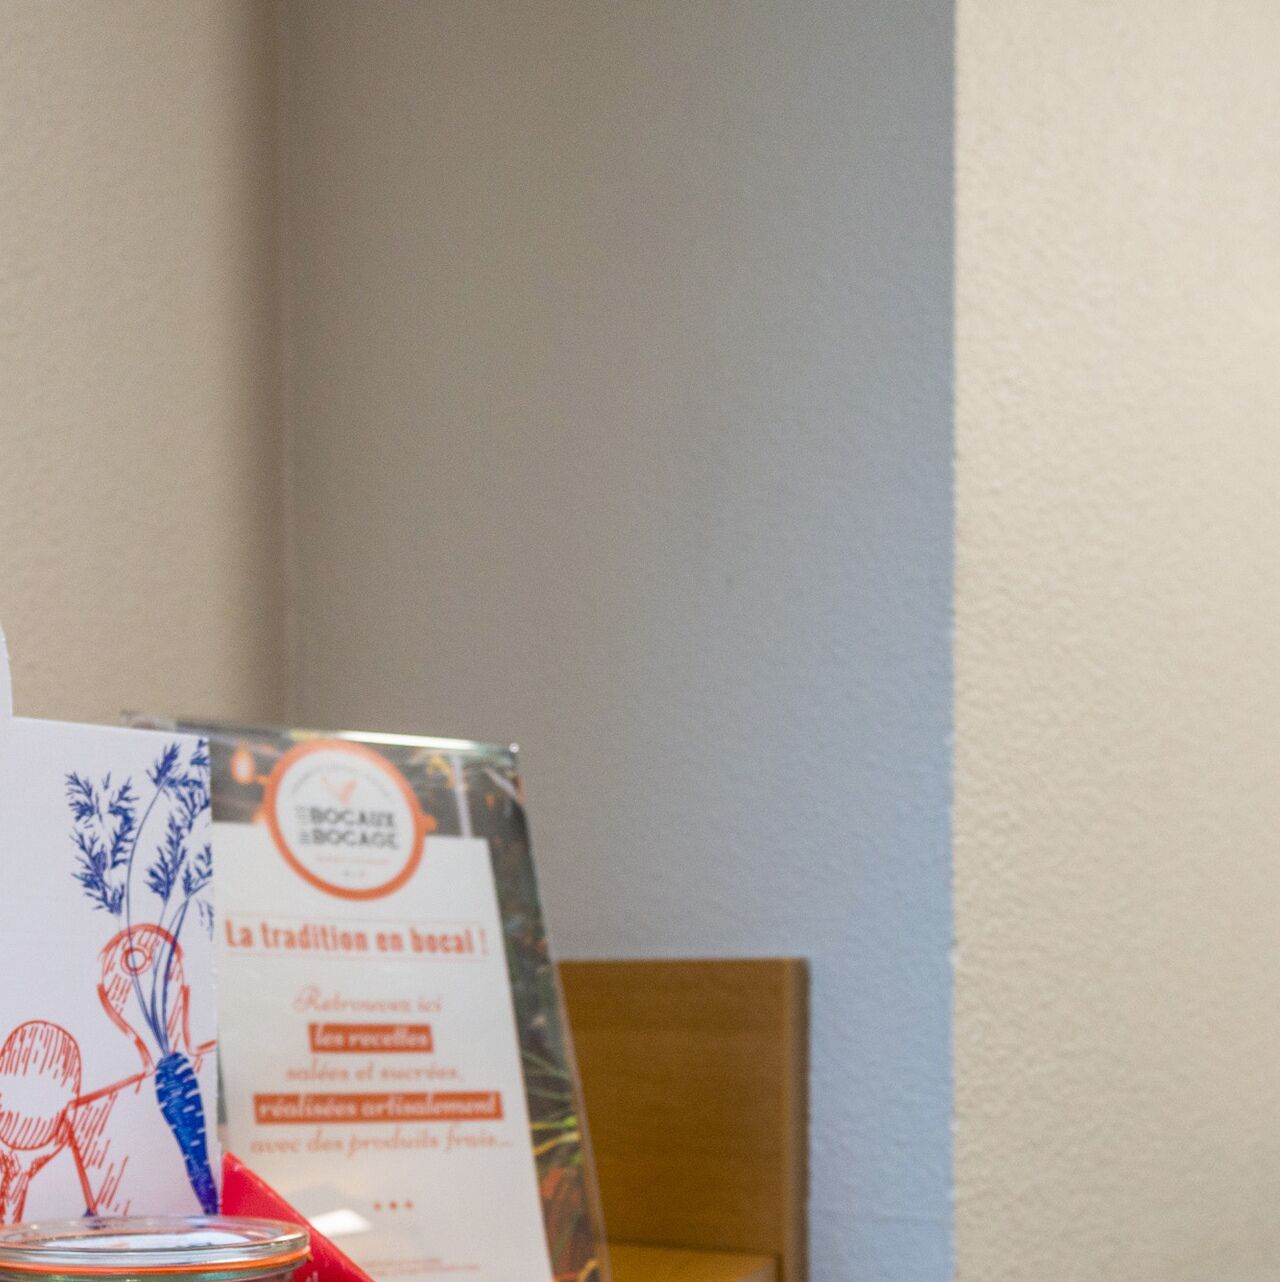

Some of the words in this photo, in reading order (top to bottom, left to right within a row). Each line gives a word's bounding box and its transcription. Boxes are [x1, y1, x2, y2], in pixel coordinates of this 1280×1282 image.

[224, 919, 254, 948] La
[261, 922, 368, 951] tradition
[375, 931, 405, 952] en
[410, 928, 474, 955] bocal
